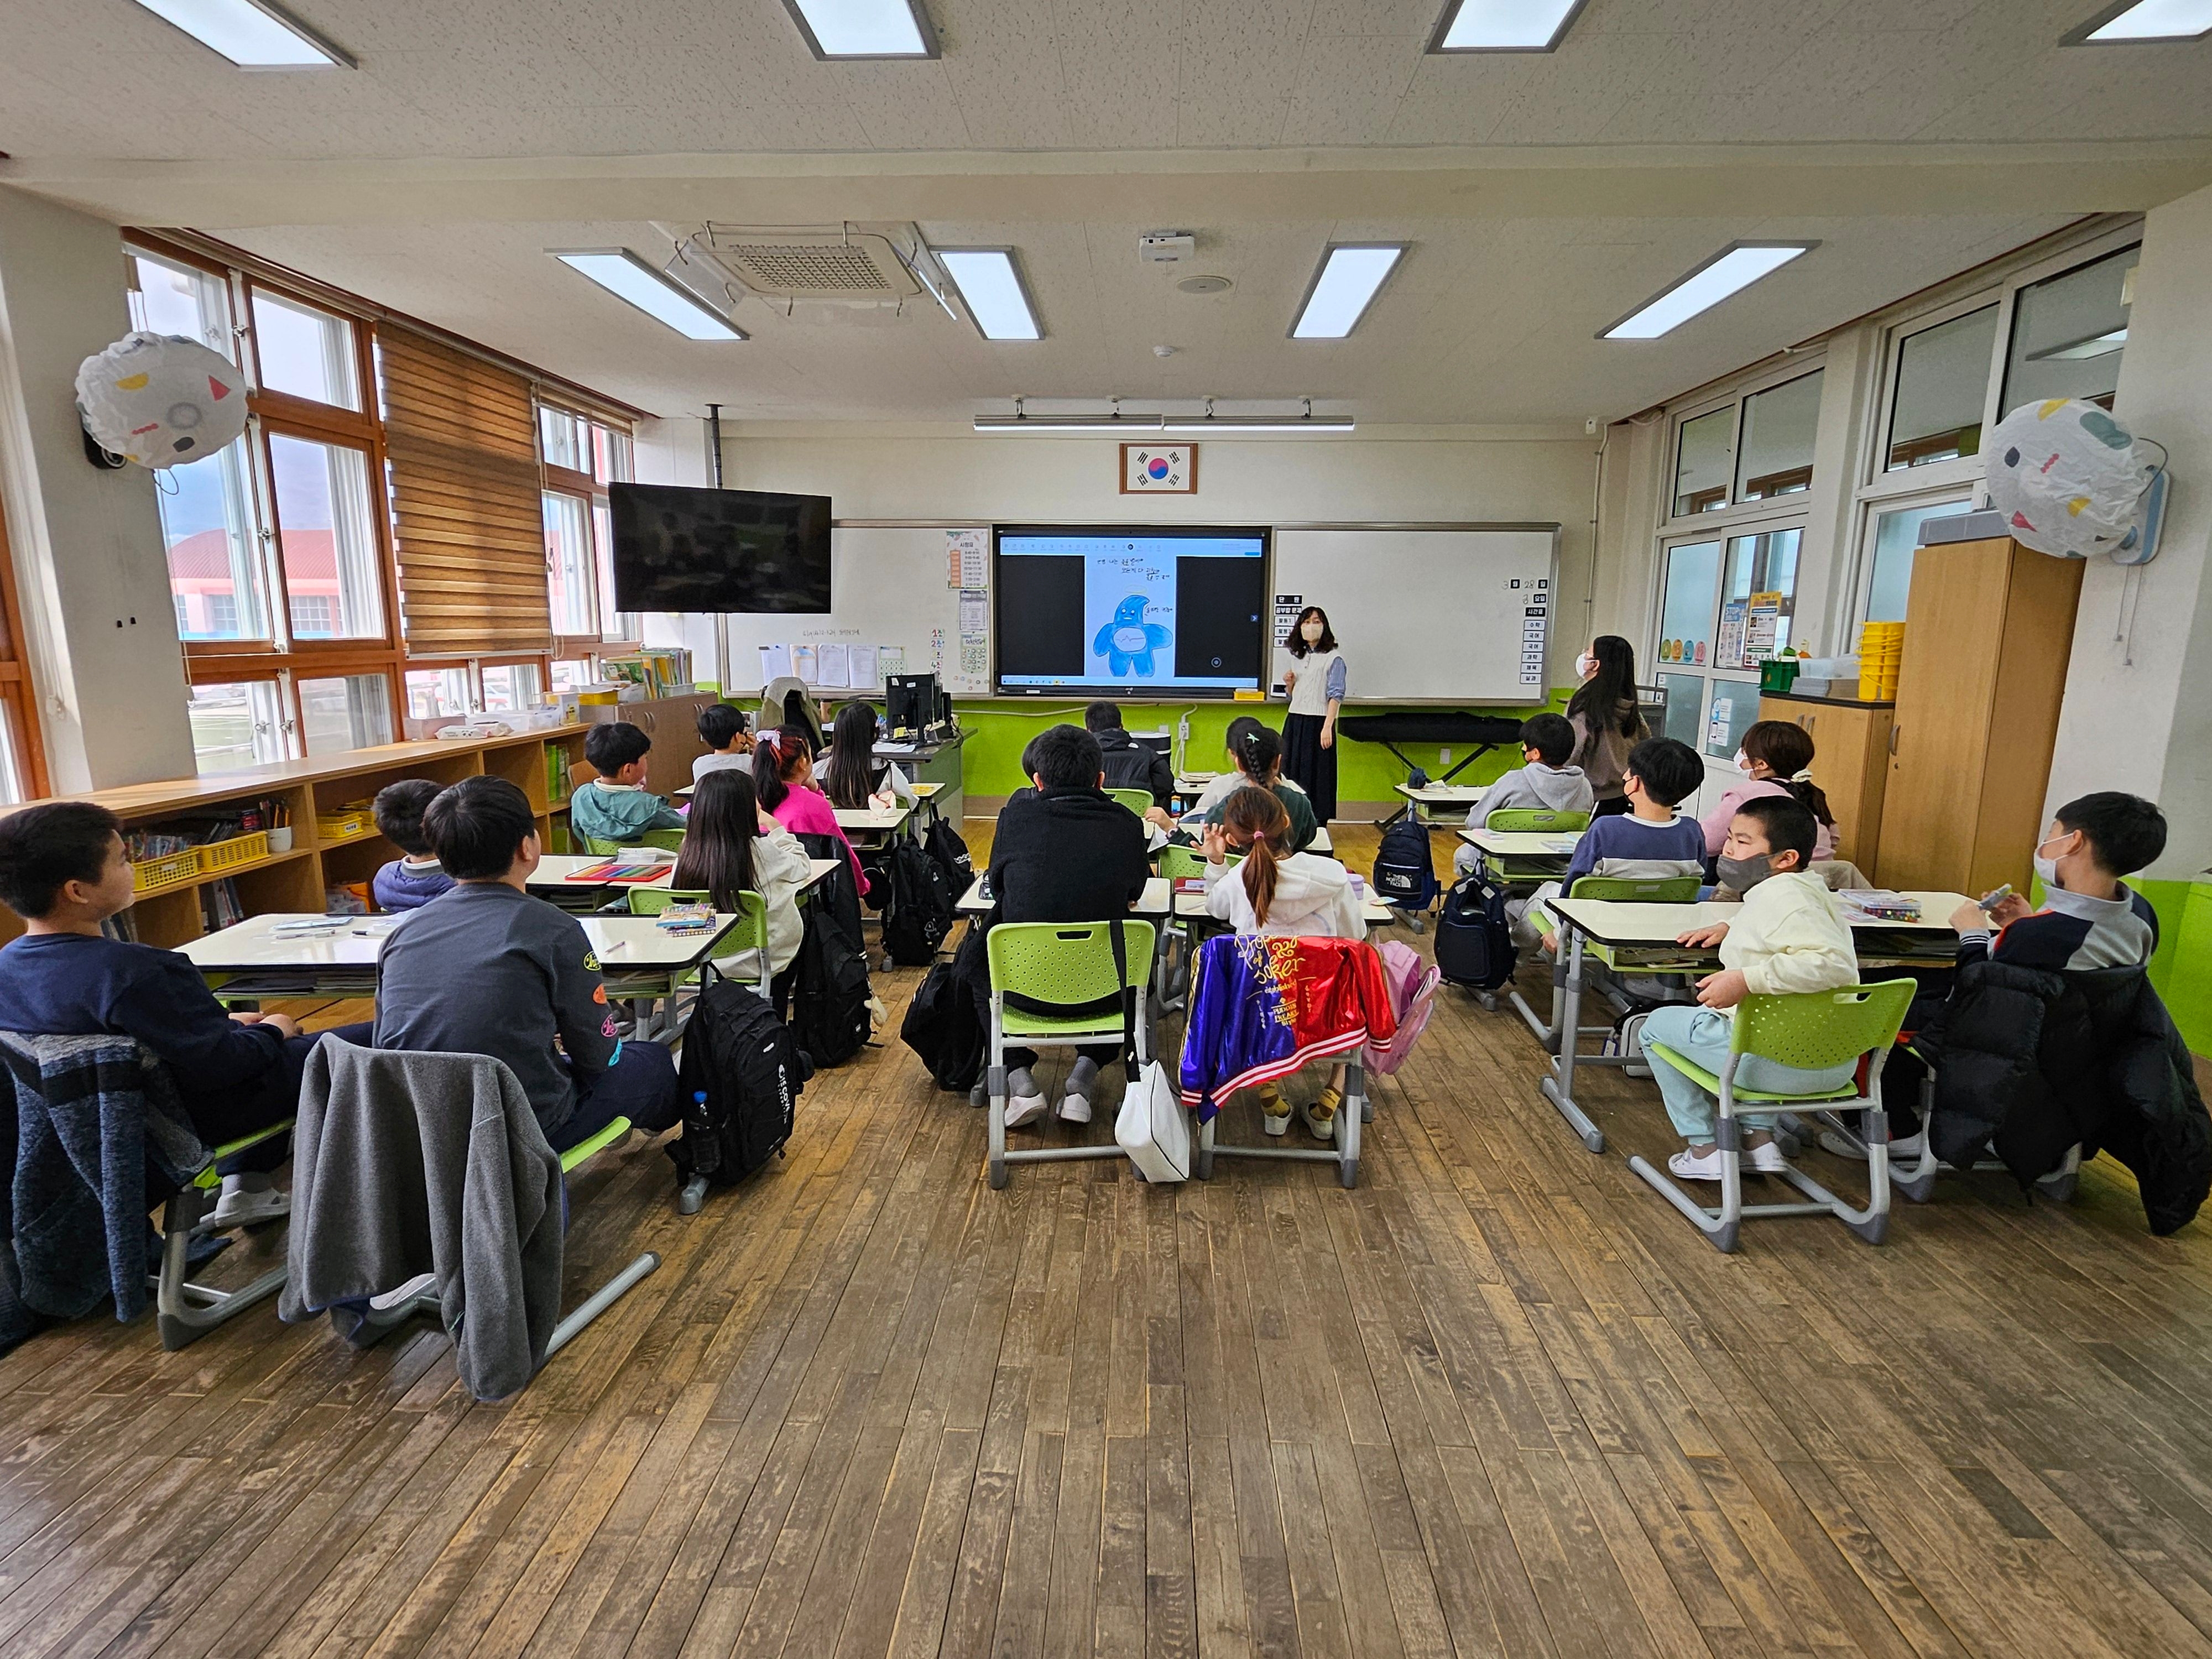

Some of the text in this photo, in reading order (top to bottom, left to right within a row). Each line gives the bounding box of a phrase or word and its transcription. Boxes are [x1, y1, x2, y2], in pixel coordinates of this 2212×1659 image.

[1501, 581, 1509, 590] 3
[1524, 580, 1535, 589] 28
[1253, 950, 1262, 967] of
[1264, 978, 1297, 994] established
